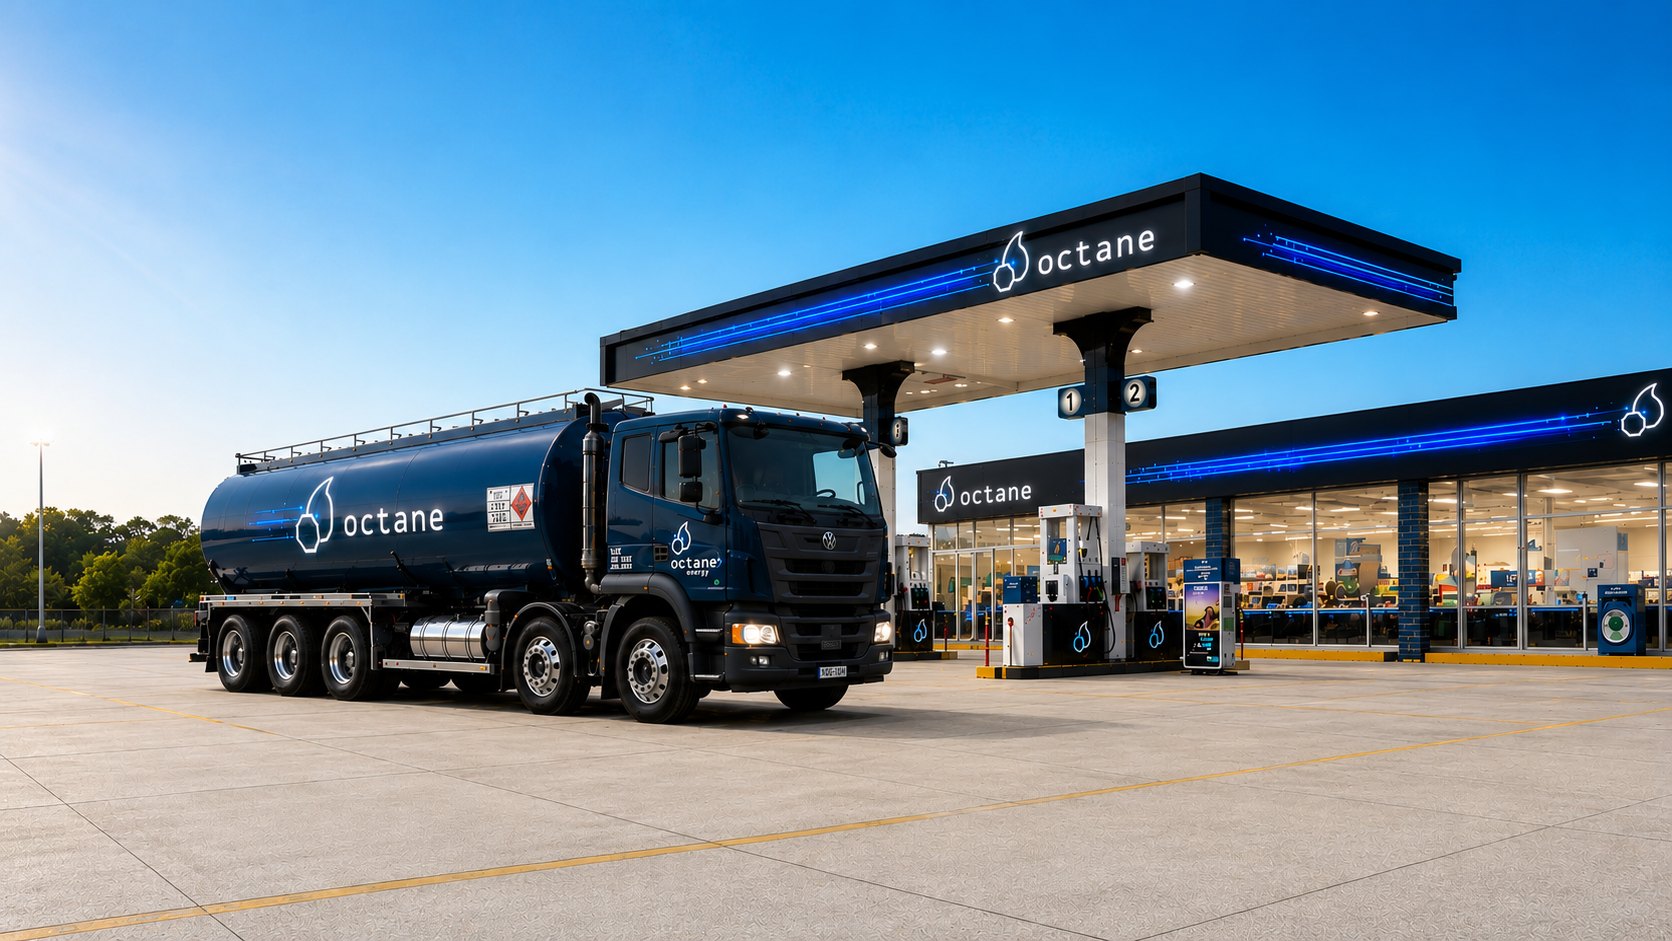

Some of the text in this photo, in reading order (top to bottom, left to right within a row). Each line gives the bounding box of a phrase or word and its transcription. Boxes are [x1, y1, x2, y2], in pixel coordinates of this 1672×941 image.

[1038, 229, 1155, 275] octane
[1066, 392, 1073, 411] 1
[1129, 383, 1140, 403] 2
[960, 485, 1032, 505] octane
[344, 507, 444, 537] octane
[670, 556, 717, 570] octane
